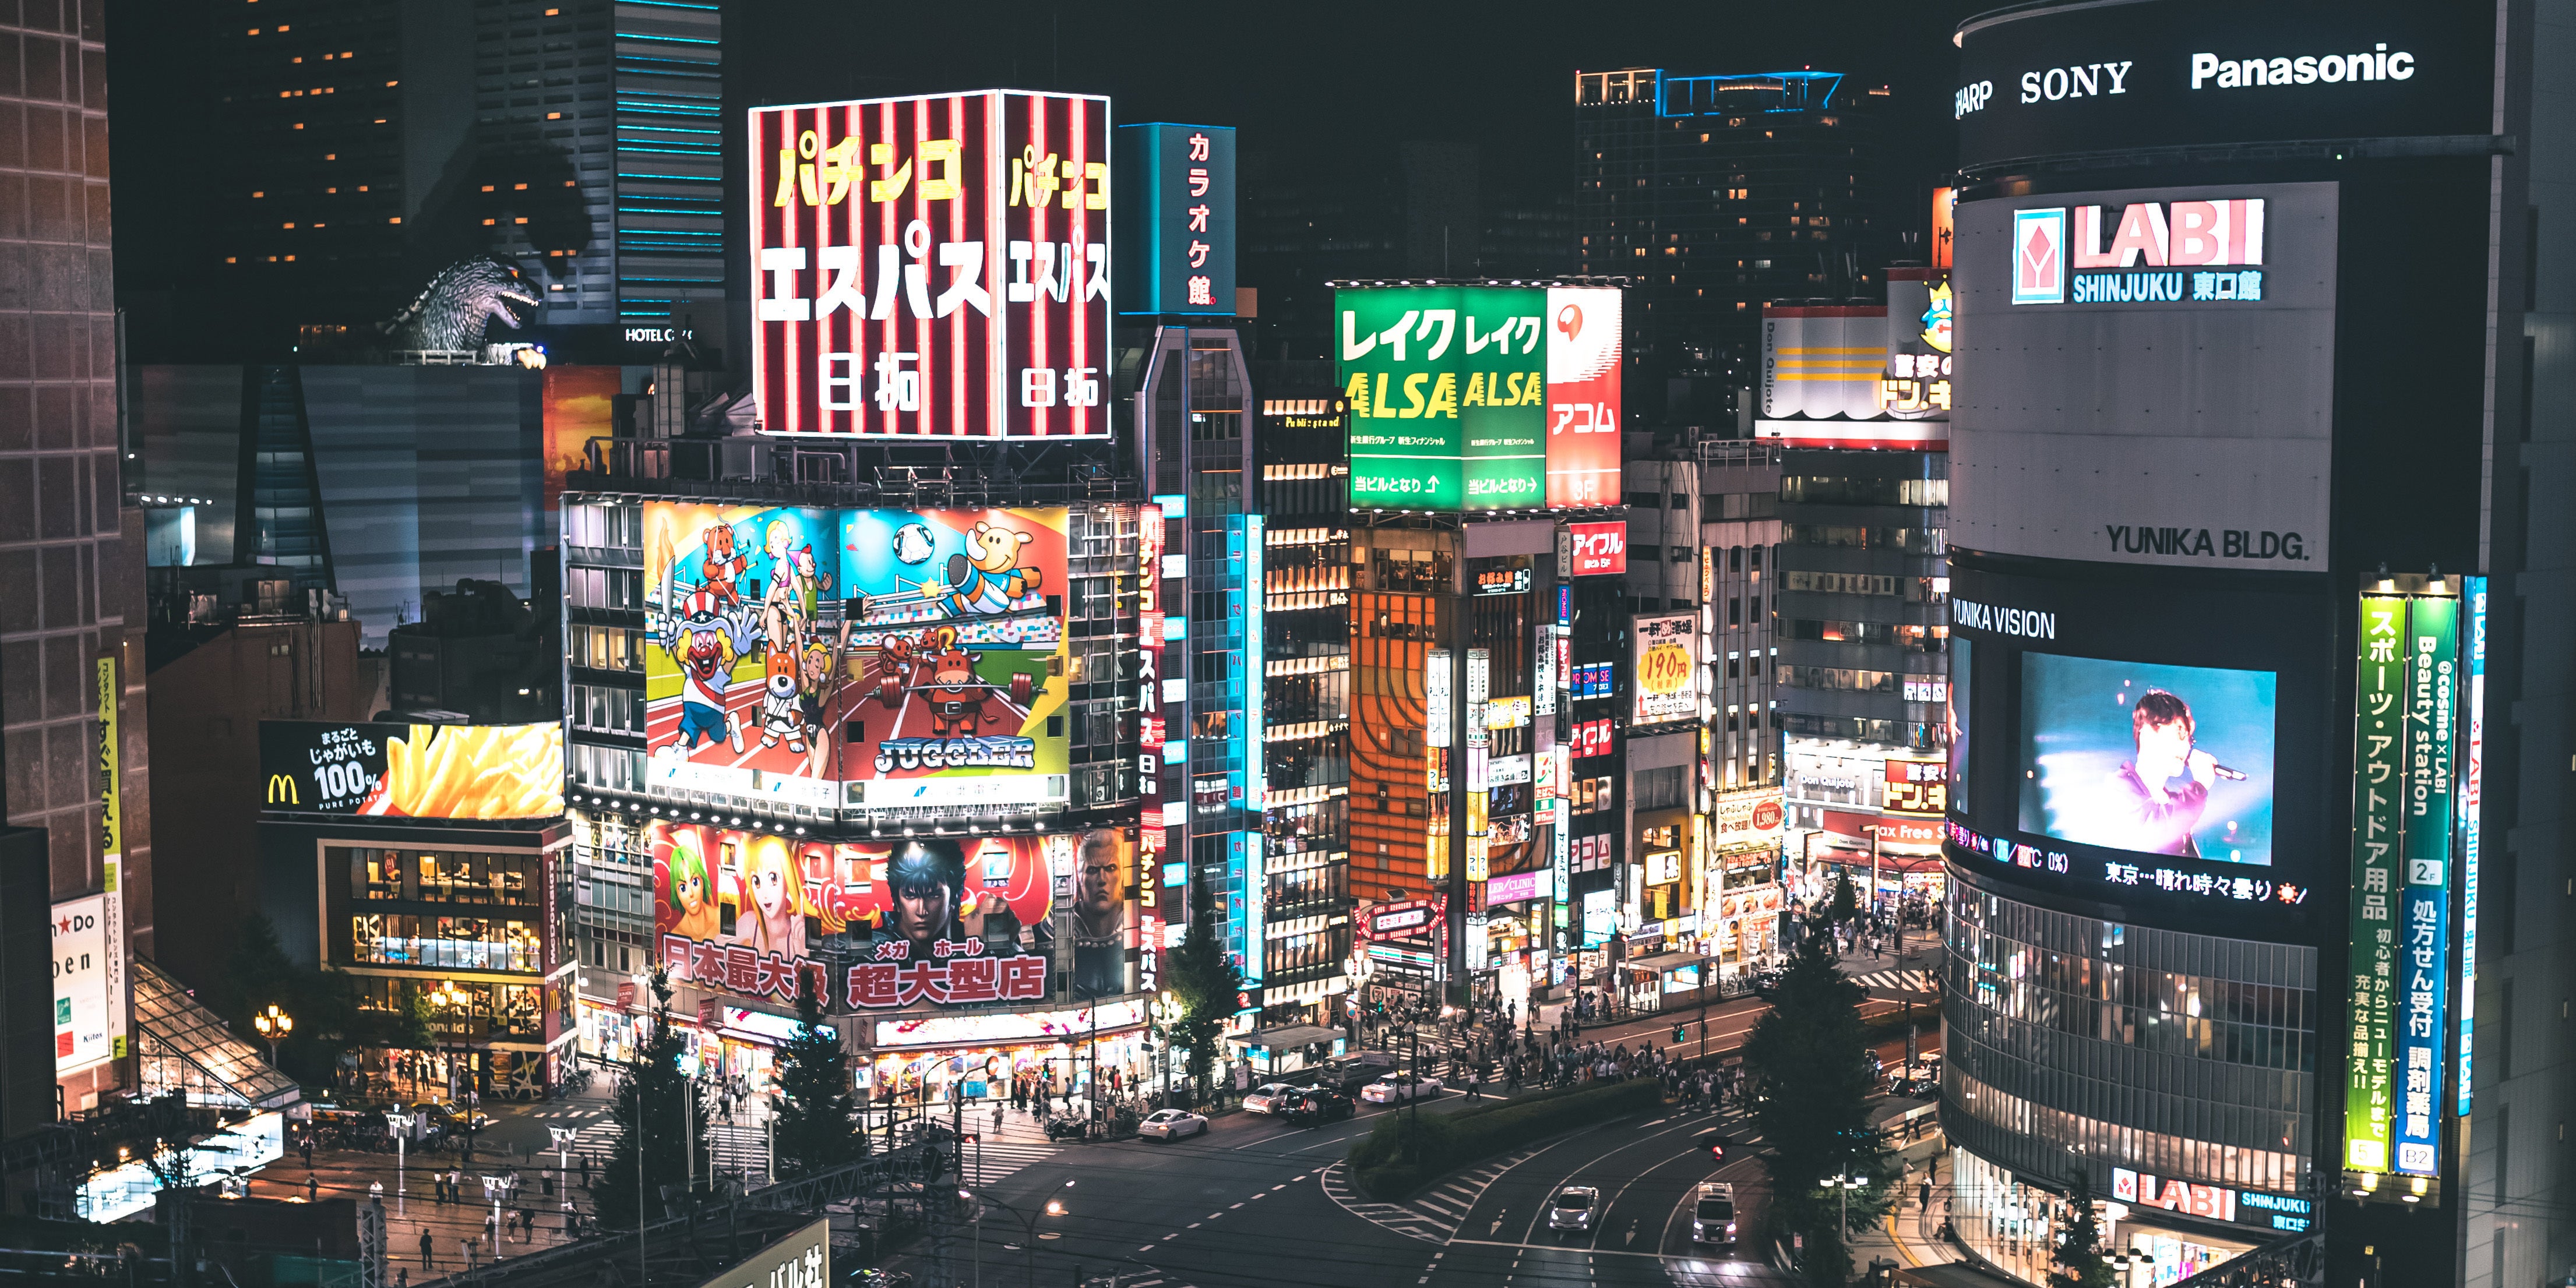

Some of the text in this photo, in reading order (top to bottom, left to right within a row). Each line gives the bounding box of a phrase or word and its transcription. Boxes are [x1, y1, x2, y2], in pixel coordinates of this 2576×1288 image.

[2021, 61, 2133, 104] SONY
[2191, 43, 2414, 90] Panasonic
[774, 130, 962, 207] パチンコ
[1009, 144, 1106, 210] パチンコ
[2074, 199, 2264, 269] LABI
[759, 219, 991, 321] エスパス
[1008, 224, 1107, 304] エスパス
[2073, 270, 2262, 302] SHINJUKU 東口館
[625, 329, 663, 342] HOTEL
[1342, 309, 1456, 361] レイク
[1465, 316, 1541, 355] レイク
[818, 352, 920, 412] 日拓
[1021, 368, 1098, 408] 日拓
[1765, 322, 1774, 414] Don Quijote
[1345, 372, 1458, 419] ALSA
[1463, 372, 1542, 407] ALSA
[1553, 403, 1616, 435] アコム
[1355, 475, 1421, 493] 当ビルとなり
[1468, 478, 1527, 495] 当ビルとなり
[1573, 532, 1623, 556] アイフル
[2106, 525, 2310, 561] YUNIKA BLDG.
[1953, 597, 2055, 640] YUNIKA VISION
[1139, 617, 1157, 744] エスパス
[1560, 648, 1568, 681] アイフル
[1647, 651, 1687, 680] 190円
[2436, 661, 2452, 741] @cosme
[321, 727, 358, 745] まるごと
[2411, 636, 2437, 816] Beauty station
[309, 739, 376, 765] じゃがいも
[873, 735, 1035, 775] JUGGLER
[1906, 764, 1946, 781] 驚安
[2362, 611, 2397, 921] スポーツ・アウトドア用品
[2469, 739, 2481, 806] LABI
[313, 760, 383, 801] 100%
[1800, 774, 1856, 789] Don Quijote
[2434, 758, 2447, 794] LABI
[319, 800, 343, 810] PURE
[1878, 826, 1897, 838] ax
[1900, 825, 1936, 839] Free
[1140, 835, 1156, 908] パチンコ
[1557, 832, 1567, 884] すしまみれ
[2416, 862, 2436, 882] 2F
[2464, 819, 2479, 919] SHINJUKU
[874, 936, 984, 960] メガ ホール
[1140, 915, 1157, 992] エスパス
[846, 956, 1046, 1008] 超大型店
[426, 1022, 474, 1034] onald's
[2352, 975, 2370, 1089] 充実な品揃え!!
[2370, 928, 2391, 1138] 初心者からニューモデルまで
[2405, 899, 2437, 1139] 処方せん受付 調剤薬局
[2405, 1150, 2429, 1165] B2
[2138, 1173, 2236, 1222] LABI
[2242, 1192, 2310, 1214] SHINJUKU
